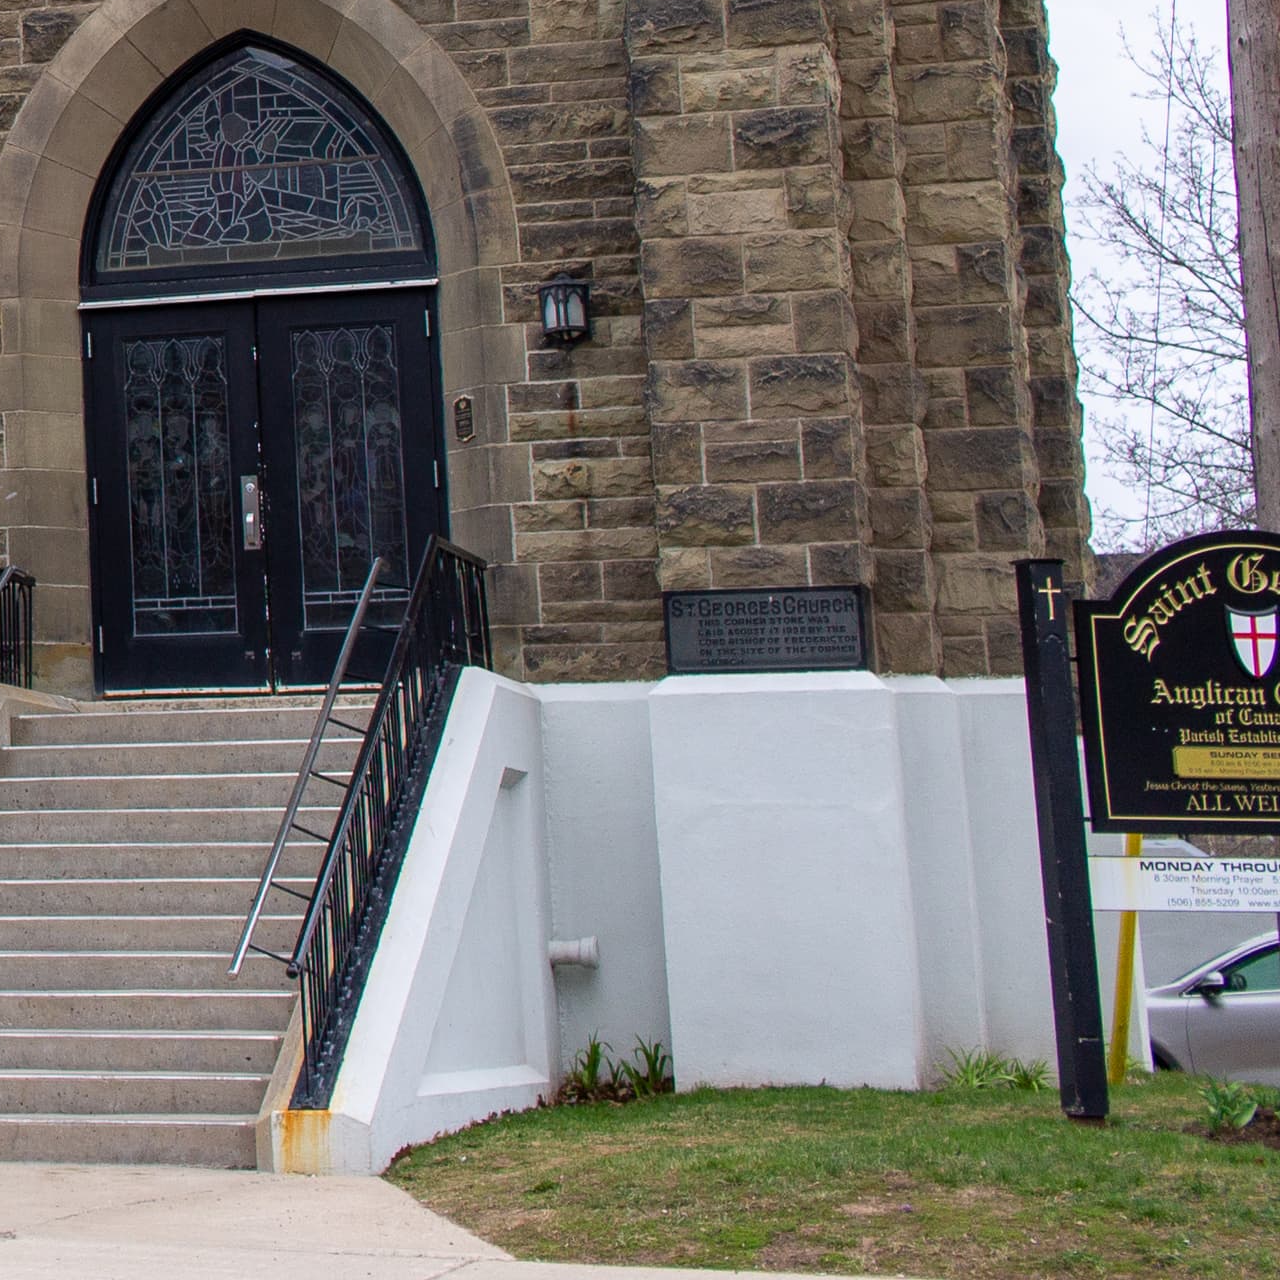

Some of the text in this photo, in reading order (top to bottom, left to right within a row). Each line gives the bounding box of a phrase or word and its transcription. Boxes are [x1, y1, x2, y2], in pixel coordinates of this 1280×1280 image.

[783, 595, 855, 614] CHURCH
[1124, 561, 1218, 662] Saint
[785, 645, 807, 655] THE
[1151, 678, 1267, 710] Anglican
[1215, 708, 1235, 725] of
[1179, 728, 1225, 746] Parish
[1210, 751, 1280, 759] SUNDAY SE
[1185, 794, 1231, 811] ALL
[1139, 861, 1280, 873] MONDAY THROU
[1192, 874, 1230, 885] Morning
[1232, 874, 1263, 886] Prayer
[1190, 886, 1234, 897] Thursday
